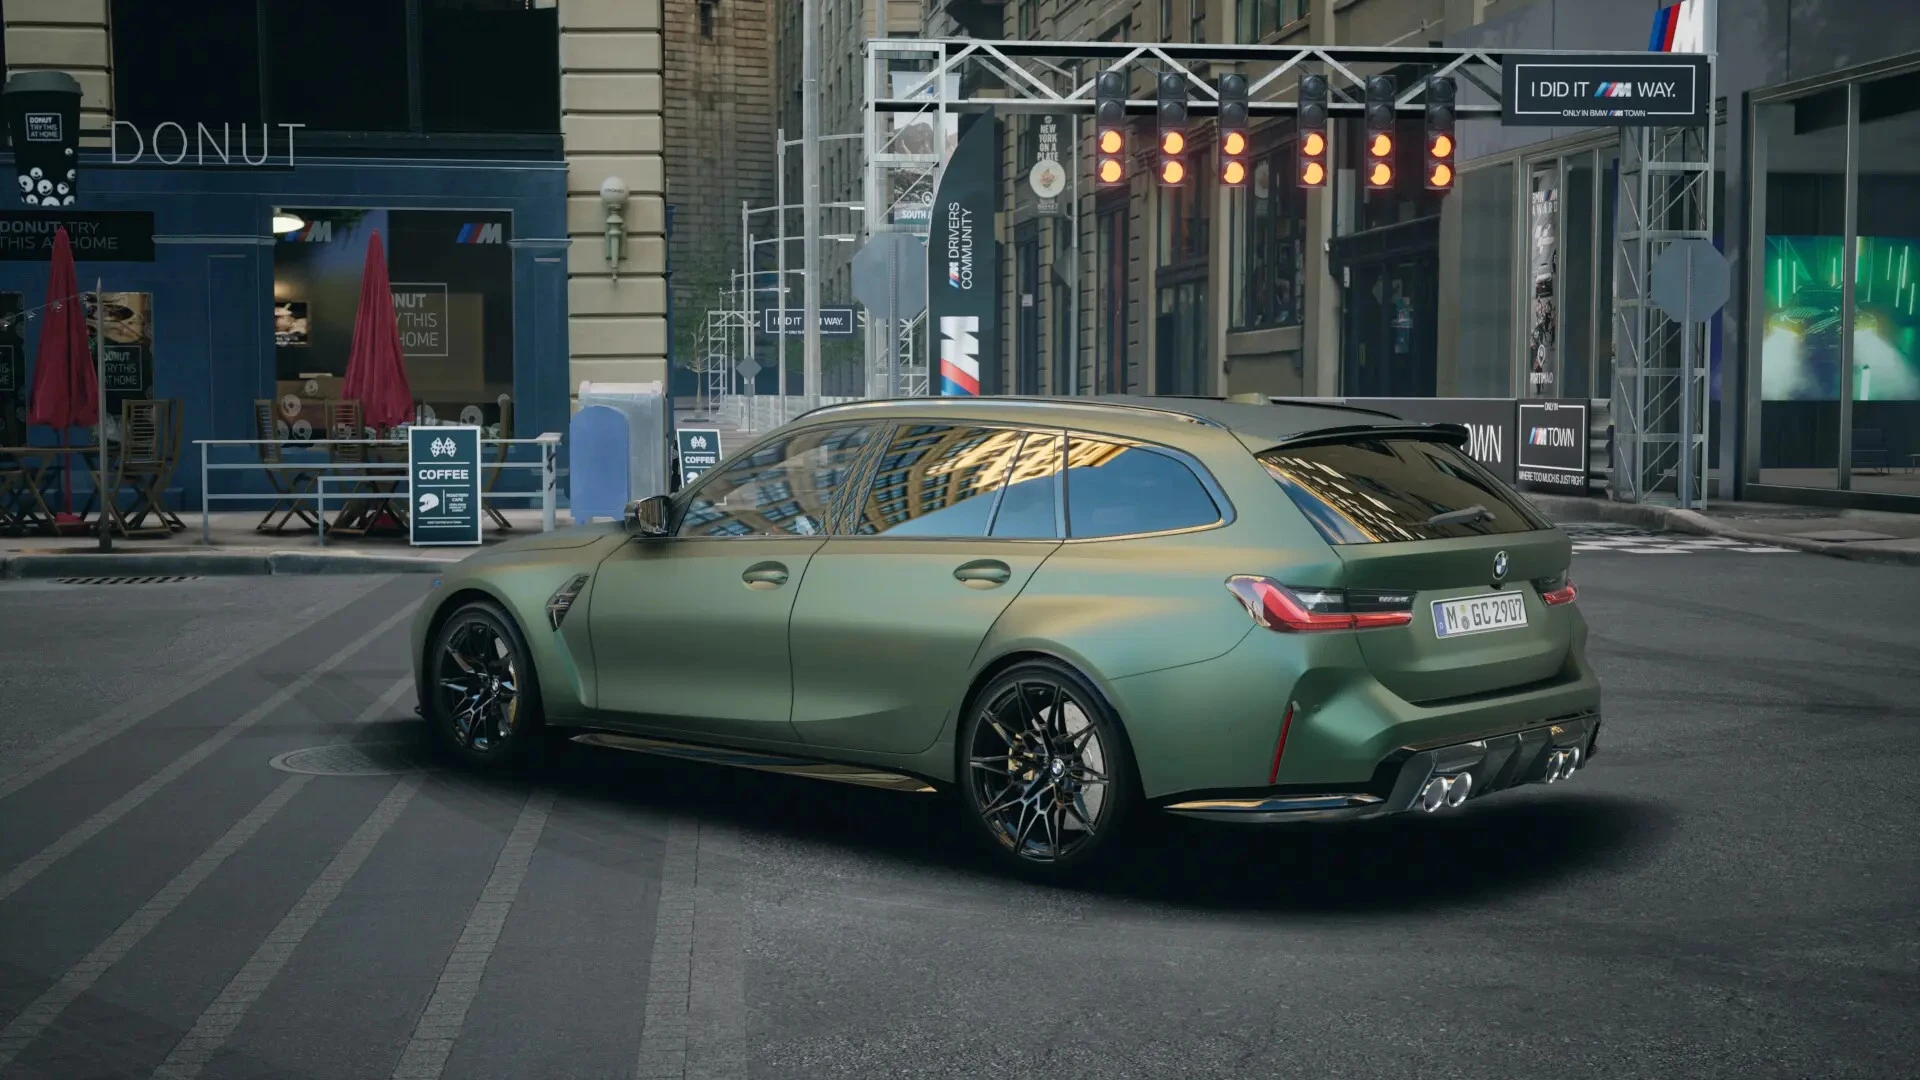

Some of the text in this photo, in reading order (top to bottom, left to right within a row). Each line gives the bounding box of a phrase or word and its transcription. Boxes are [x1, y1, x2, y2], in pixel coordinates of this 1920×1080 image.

[1531, 82, 1535, 97] I
[1540, 82, 1569, 97] DID
[1574, 82, 1590, 97] IT
[1637, 81, 1676, 98] WAY.
[1562, 109, 1580, 117] ONLY
[1589, 109, 1608, 117] BMW
[29, 116, 53, 124] DONUT
[1040, 124, 1057, 134] NEW
[111, 120, 306, 166] DONUT
[1039, 133, 1058, 143] YORK
[1039, 143, 1057, 152] ON A
[1037, 152, 1059, 161] PLATE
[902, 209, 926, 219] SOUTH
[0, 220, 100, 235] DONUT TRY
[948, 202, 960, 259] DRIVERS
[0, 236, 36, 249] THIS
[42, 237, 56, 248] A
[961, 207, 973, 290] COMMUNITY
[391, 293, 427, 308] NUT
[403, 312, 438, 328] THIS
[823, 317, 844, 326] WAY.
[118, 363, 137, 373] THIS
[113, 375, 137, 385] HOME
[1544, 402, 1559, 411] ONLY IN
[1457, 422, 1502, 464] OWN
[1547, 427, 1575, 448] TOWN
[684, 456, 716, 464] COFFEE
[418, 469, 469, 480] COFFEE
[1519, 470, 1533, 481] WHERE
[1533, 471, 1543, 482] TOO
[1543, 472, 1555, 483] MUCH
[1560, 474, 1570, 485] JUST
[1570, 475, 1584, 486] RIGHT
[1446, 598, 1522, 630] M GC 2907
